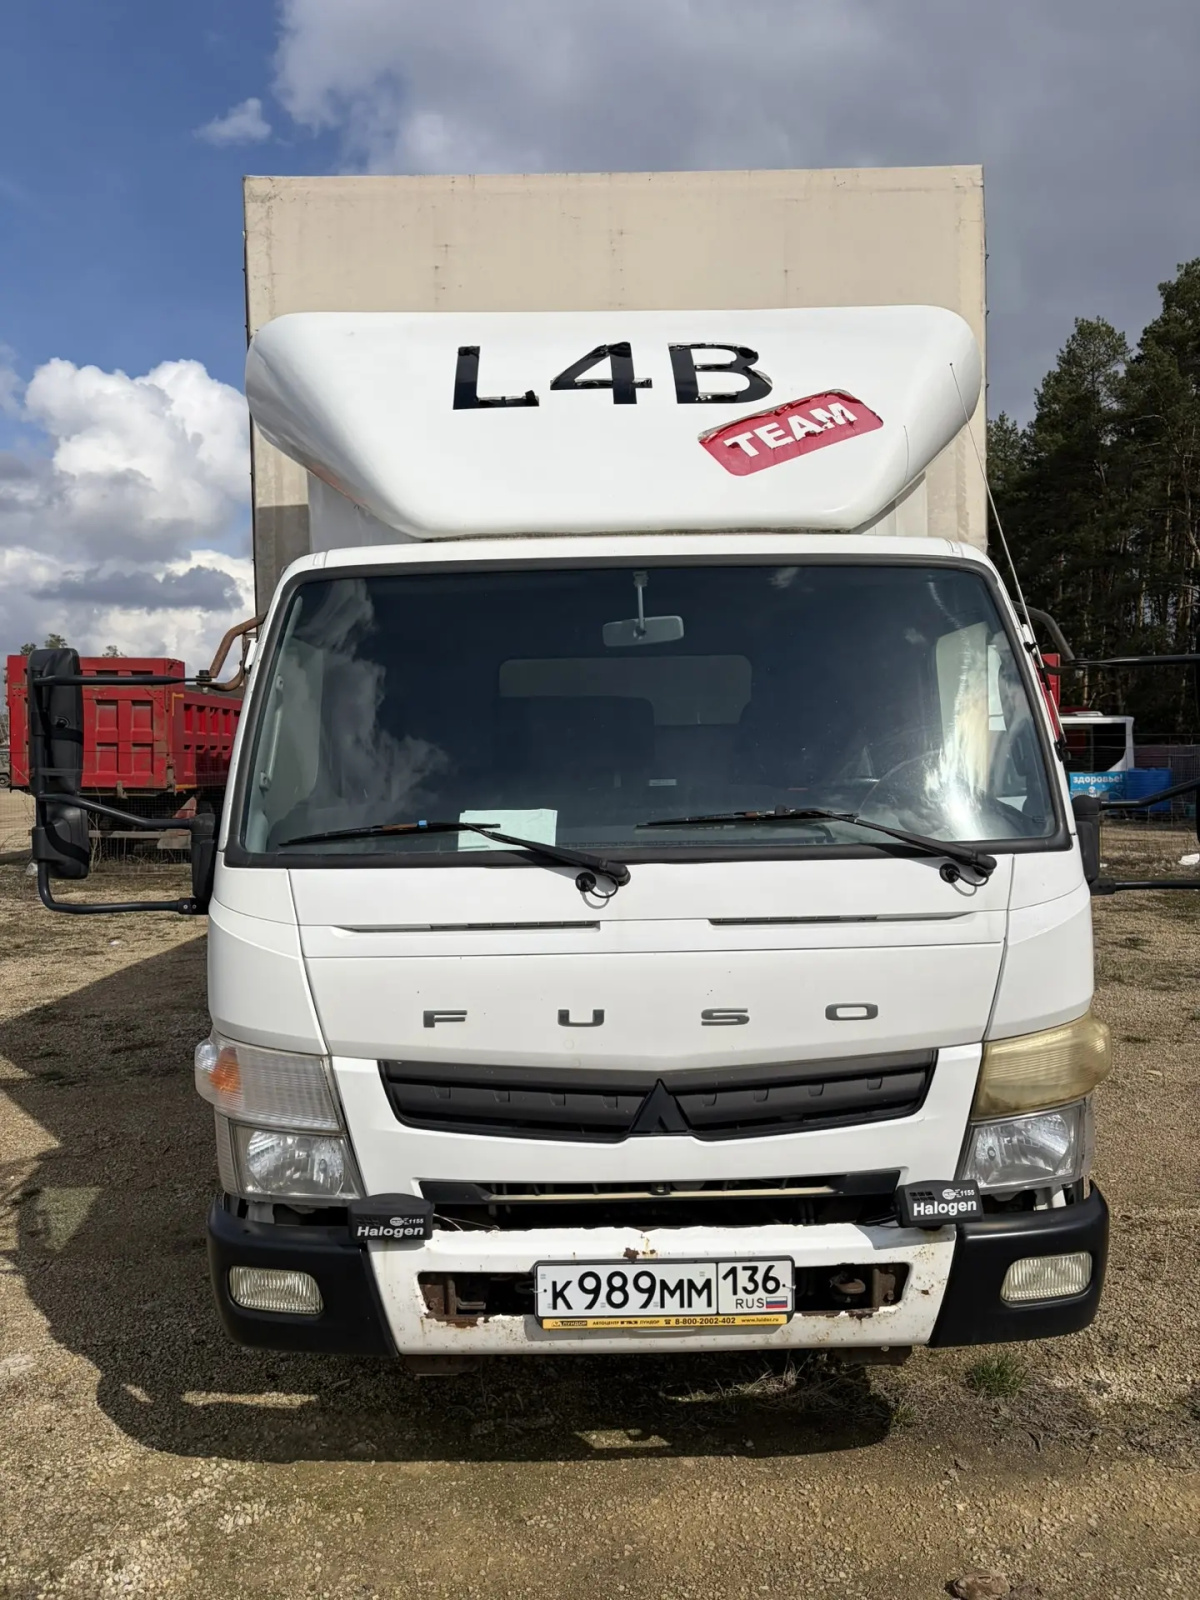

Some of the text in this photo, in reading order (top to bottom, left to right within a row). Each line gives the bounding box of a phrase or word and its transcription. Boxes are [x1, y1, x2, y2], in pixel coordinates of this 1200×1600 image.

[453, 341, 773, 410] L4B
[723, 401, 859, 458] TEAM
[1073, 774, 1122, 785] здоровье!
[423, 1002, 879, 1028] FUSO
[913, 1200, 977, 1216] Halogen
[357, 1226, 424, 1238] Halogen
[722, 1264, 781, 1297] 136
[734, 1297, 765, 1310] RUS
[674, 1317, 736, 1325] 8-800-2002-402
